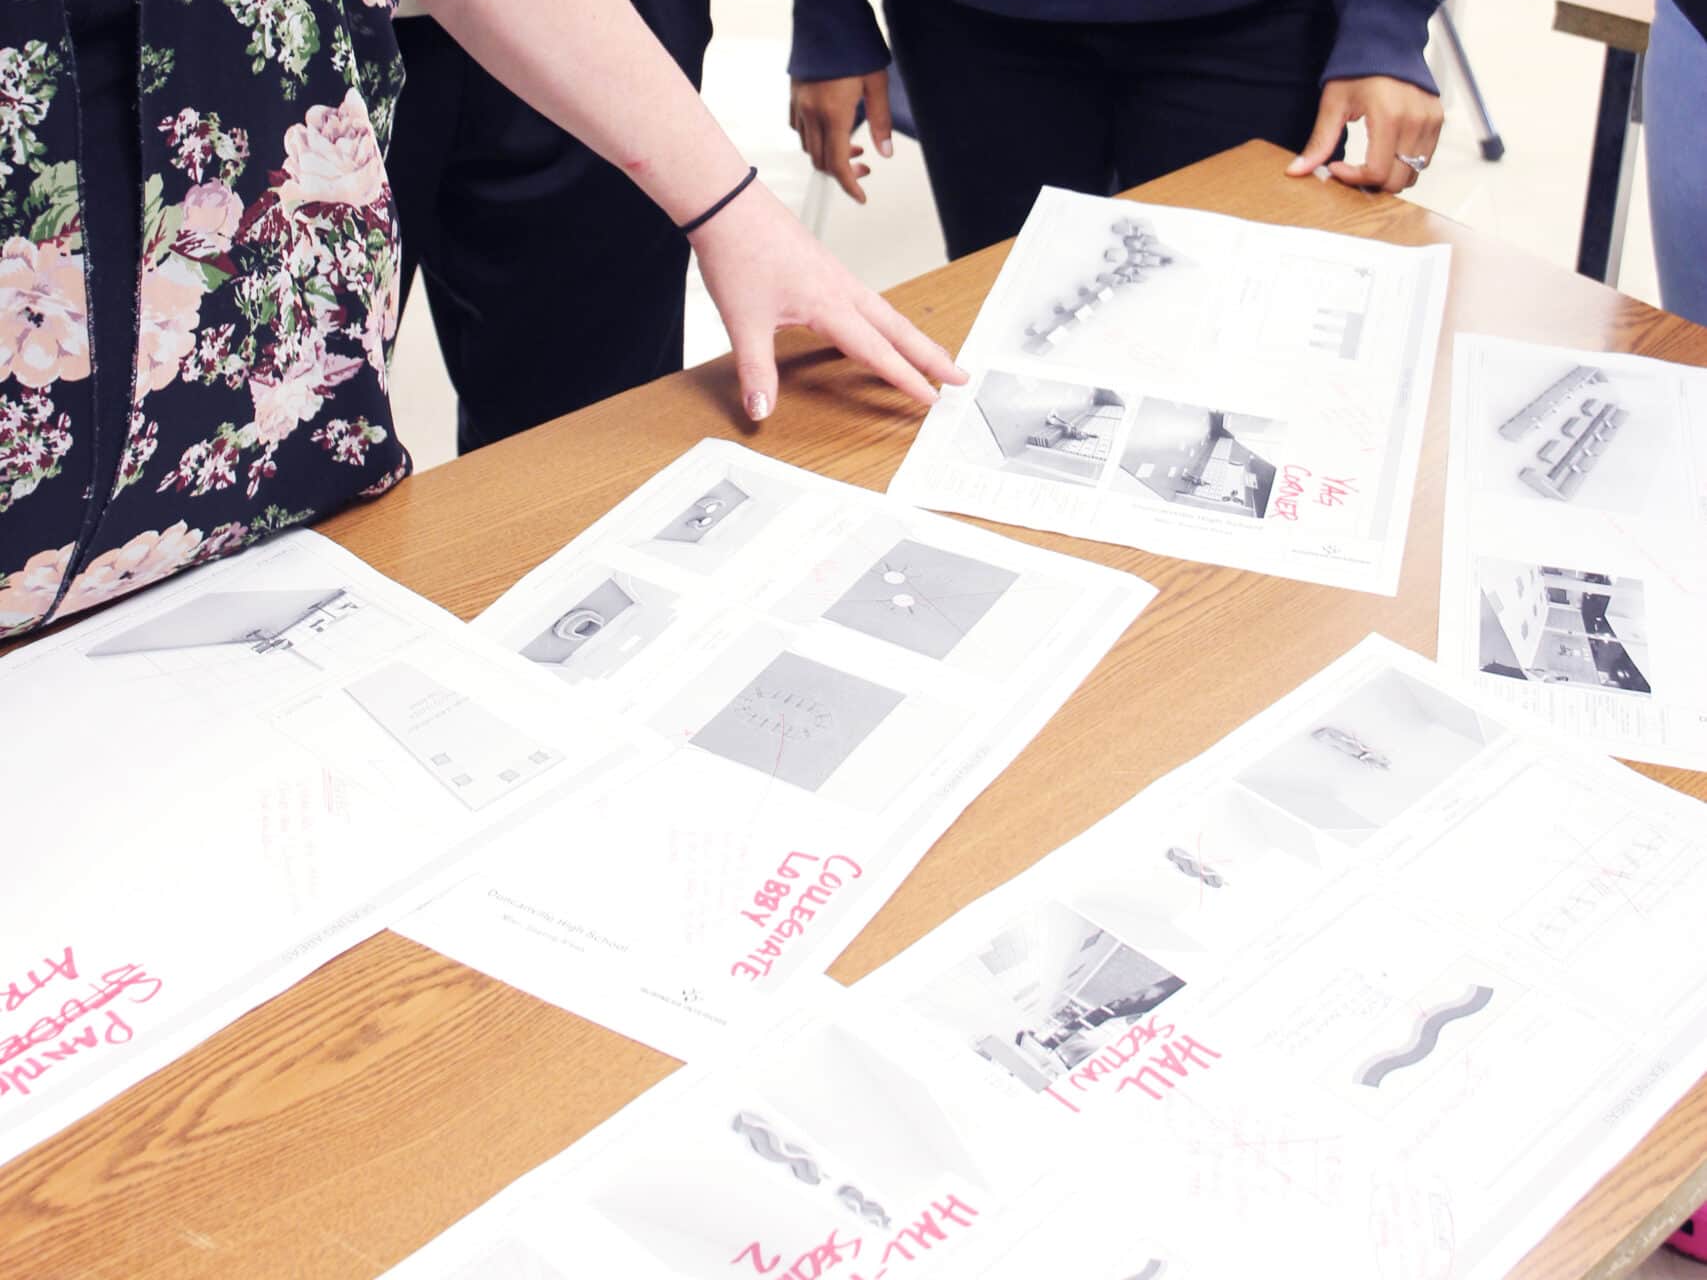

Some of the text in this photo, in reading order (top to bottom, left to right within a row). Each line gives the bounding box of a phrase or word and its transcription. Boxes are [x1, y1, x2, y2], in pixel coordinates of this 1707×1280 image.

[1268, 463, 1313, 521] CORNER
[731, 854, 863, 981] COLLEGIATE
[740, 851, 820, 928] LOBBY
[0, 946, 79, 1012] ATR
[1069, 1014, 1176, 1092] SECTION
[1115, 1034, 1222, 1101] HALL
[730, 1242, 781, 1275] 2
[850, 1194, 979, 1280] HALL-
